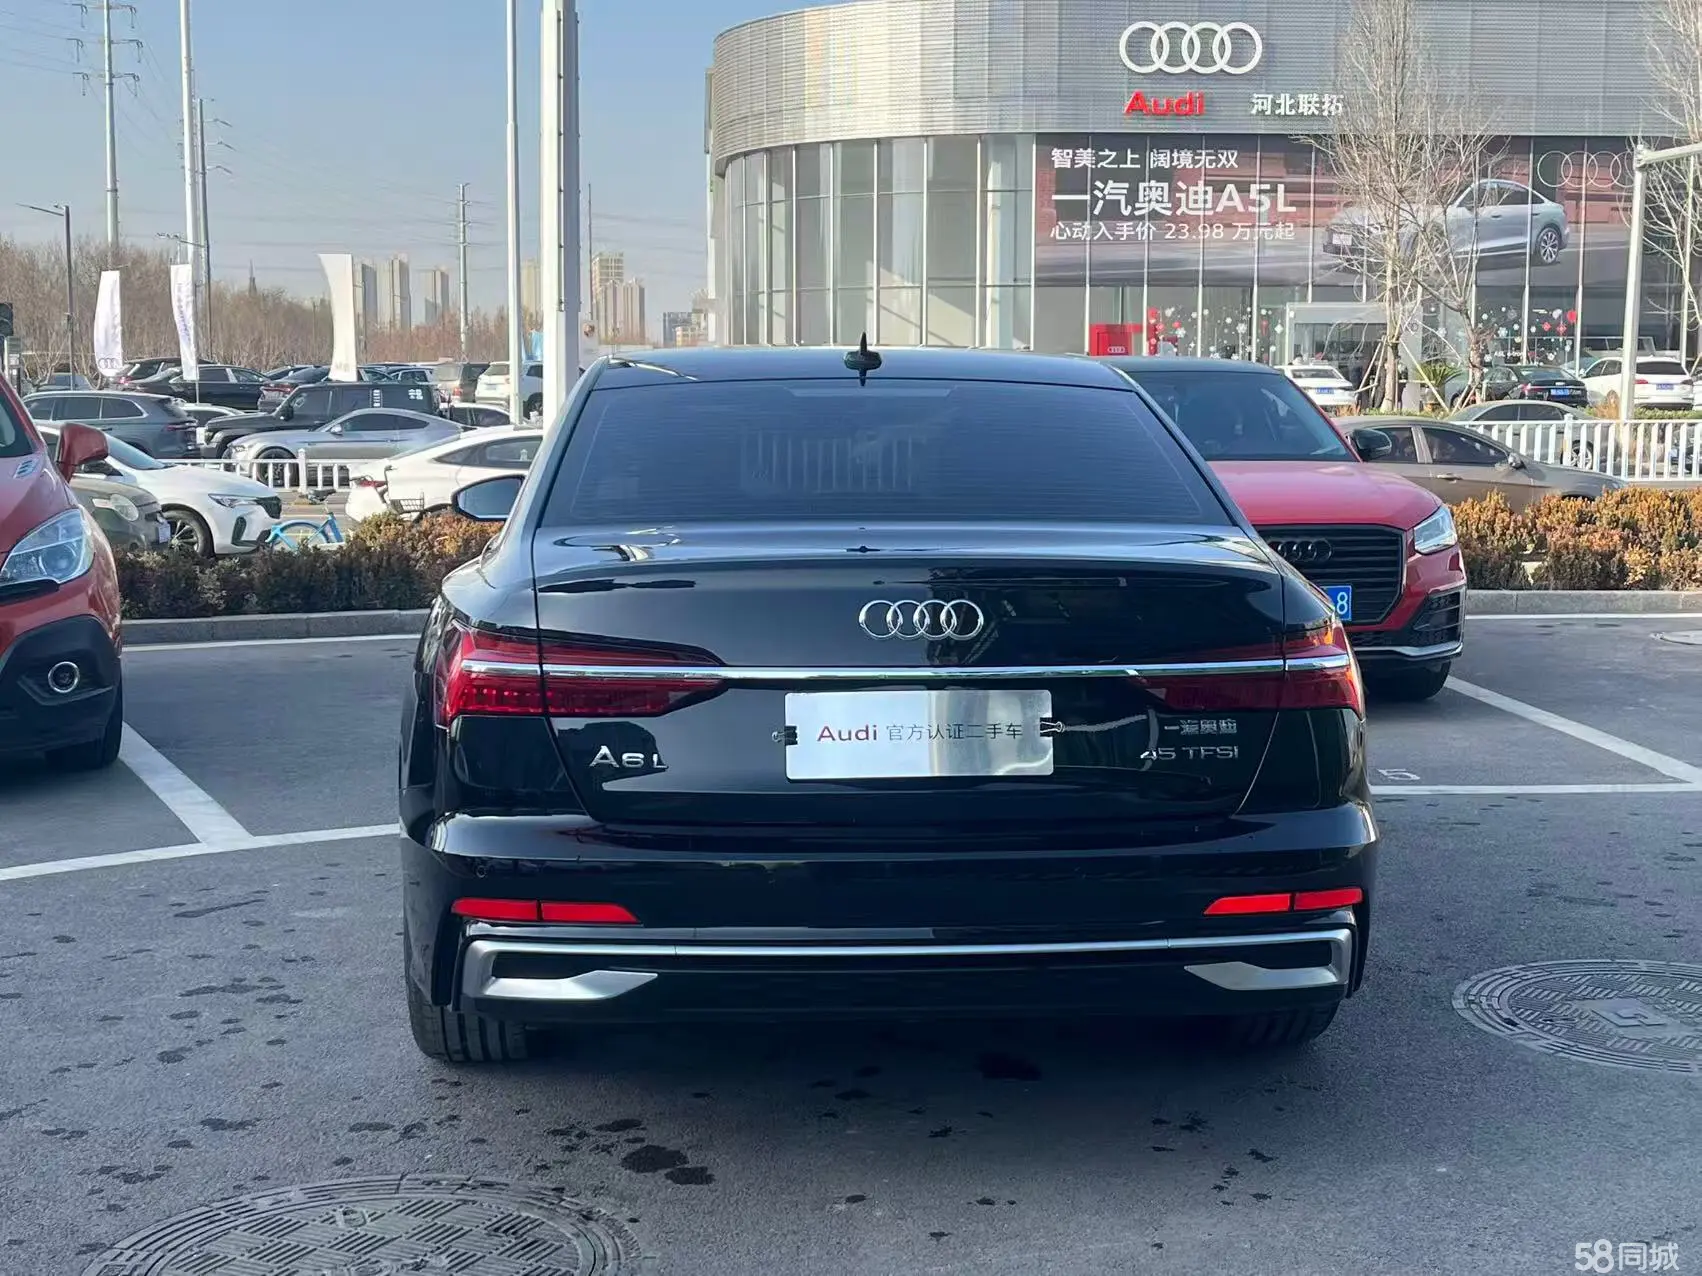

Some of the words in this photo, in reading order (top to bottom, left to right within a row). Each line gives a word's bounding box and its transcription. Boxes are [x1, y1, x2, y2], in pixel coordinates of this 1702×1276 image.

[1124, 90, 1205, 116] Audi
[1250, 92, 1345, 116] 河北联拓
[1051, 148, 1141, 169] 智美之上
[1150, 148, 1239, 169] 阔境无双
[1051, 179, 1297, 216] 一汽奥迪A5L
[1050, 221, 1157, 241] 心动入手价
[1164, 223, 1224, 240] 23.98
[1232, 221, 1295, 241] 万元起
[816, 724, 878, 742] Audi
[885, 722, 1024, 743] 官方认证二手车
[589, 745, 669, 769] A6L
[1140, 747, 1177, 760] 45
[1181, 745, 1239, 760] TFSI
